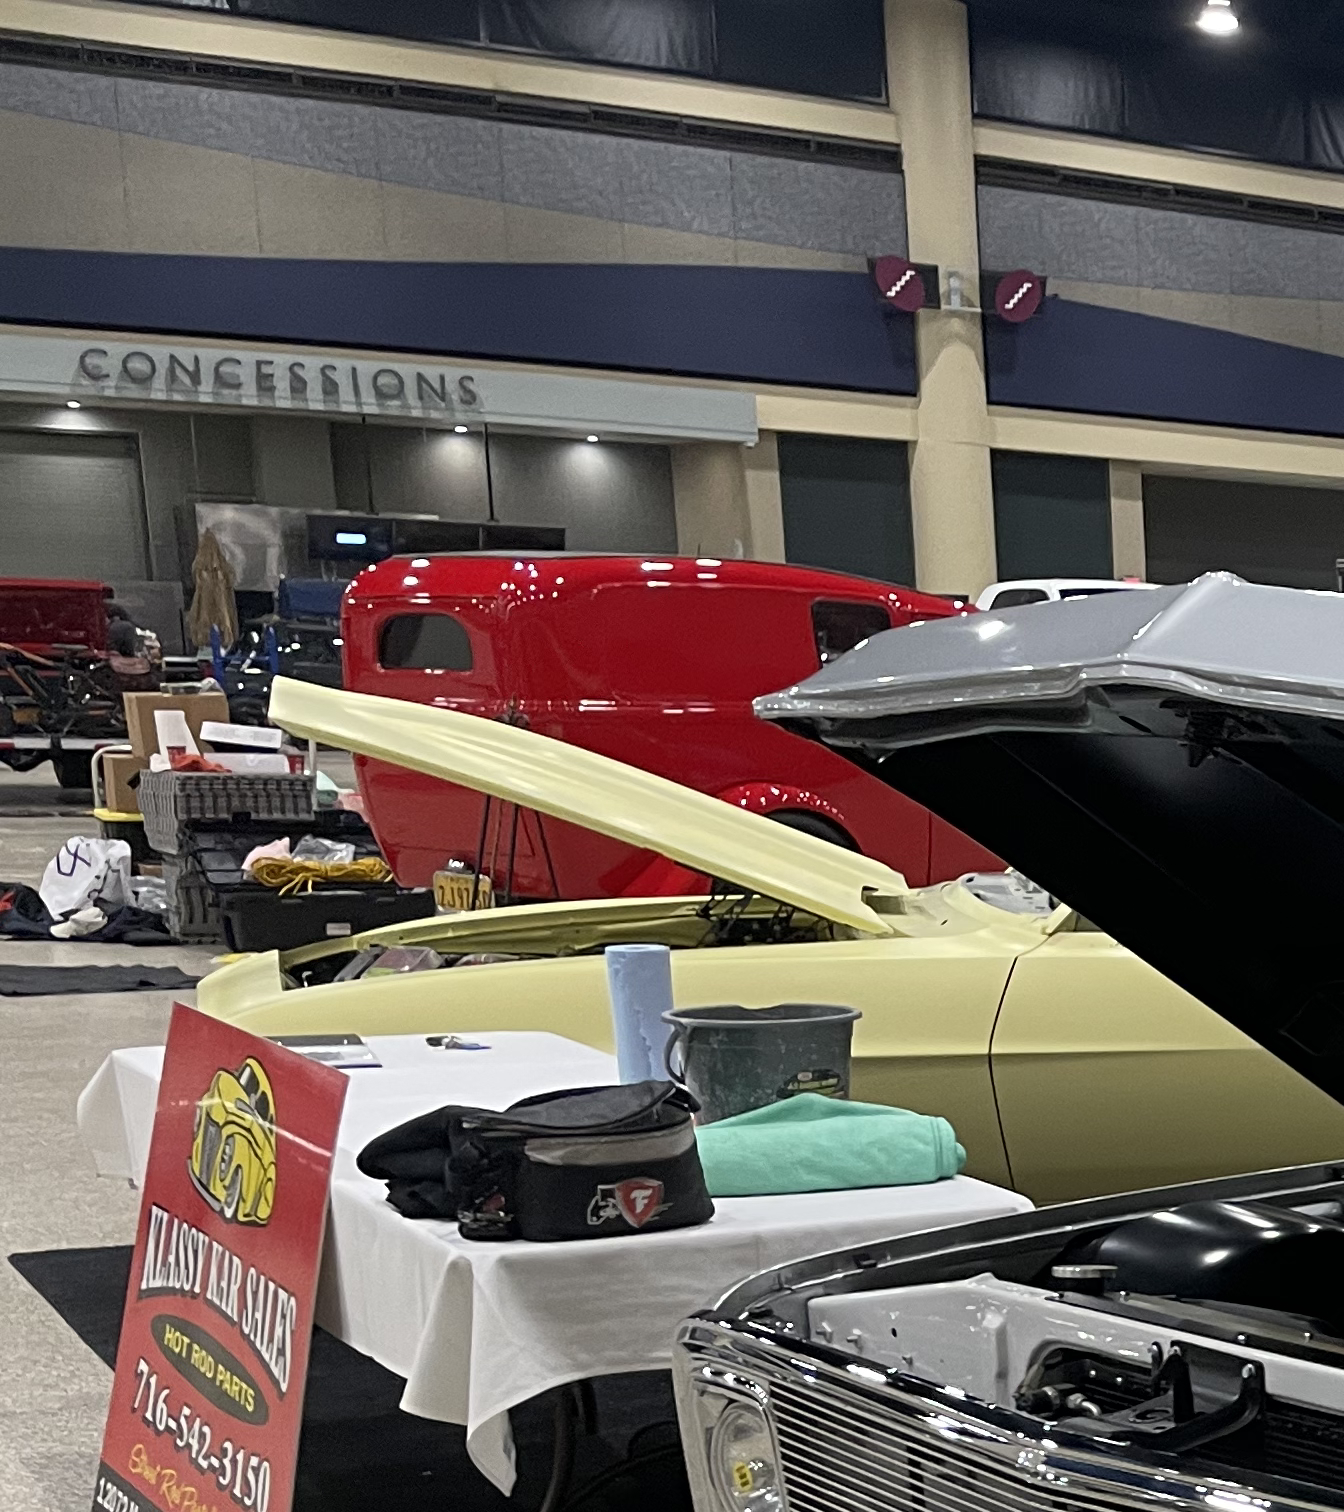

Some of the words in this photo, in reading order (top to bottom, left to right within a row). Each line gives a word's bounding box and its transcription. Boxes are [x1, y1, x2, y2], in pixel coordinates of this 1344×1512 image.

[79, 348, 479, 408] CONCESSIONS
[141, 1204, 209, 1294] KLASSY
[206, 1240, 242, 1322] KAR
[241, 1266, 297, 1392] SALES
[164, 1324, 188, 1358] HOT
[191, 1343, 214, 1378] ROD
[216, 1366, 255, 1412] PARTS
